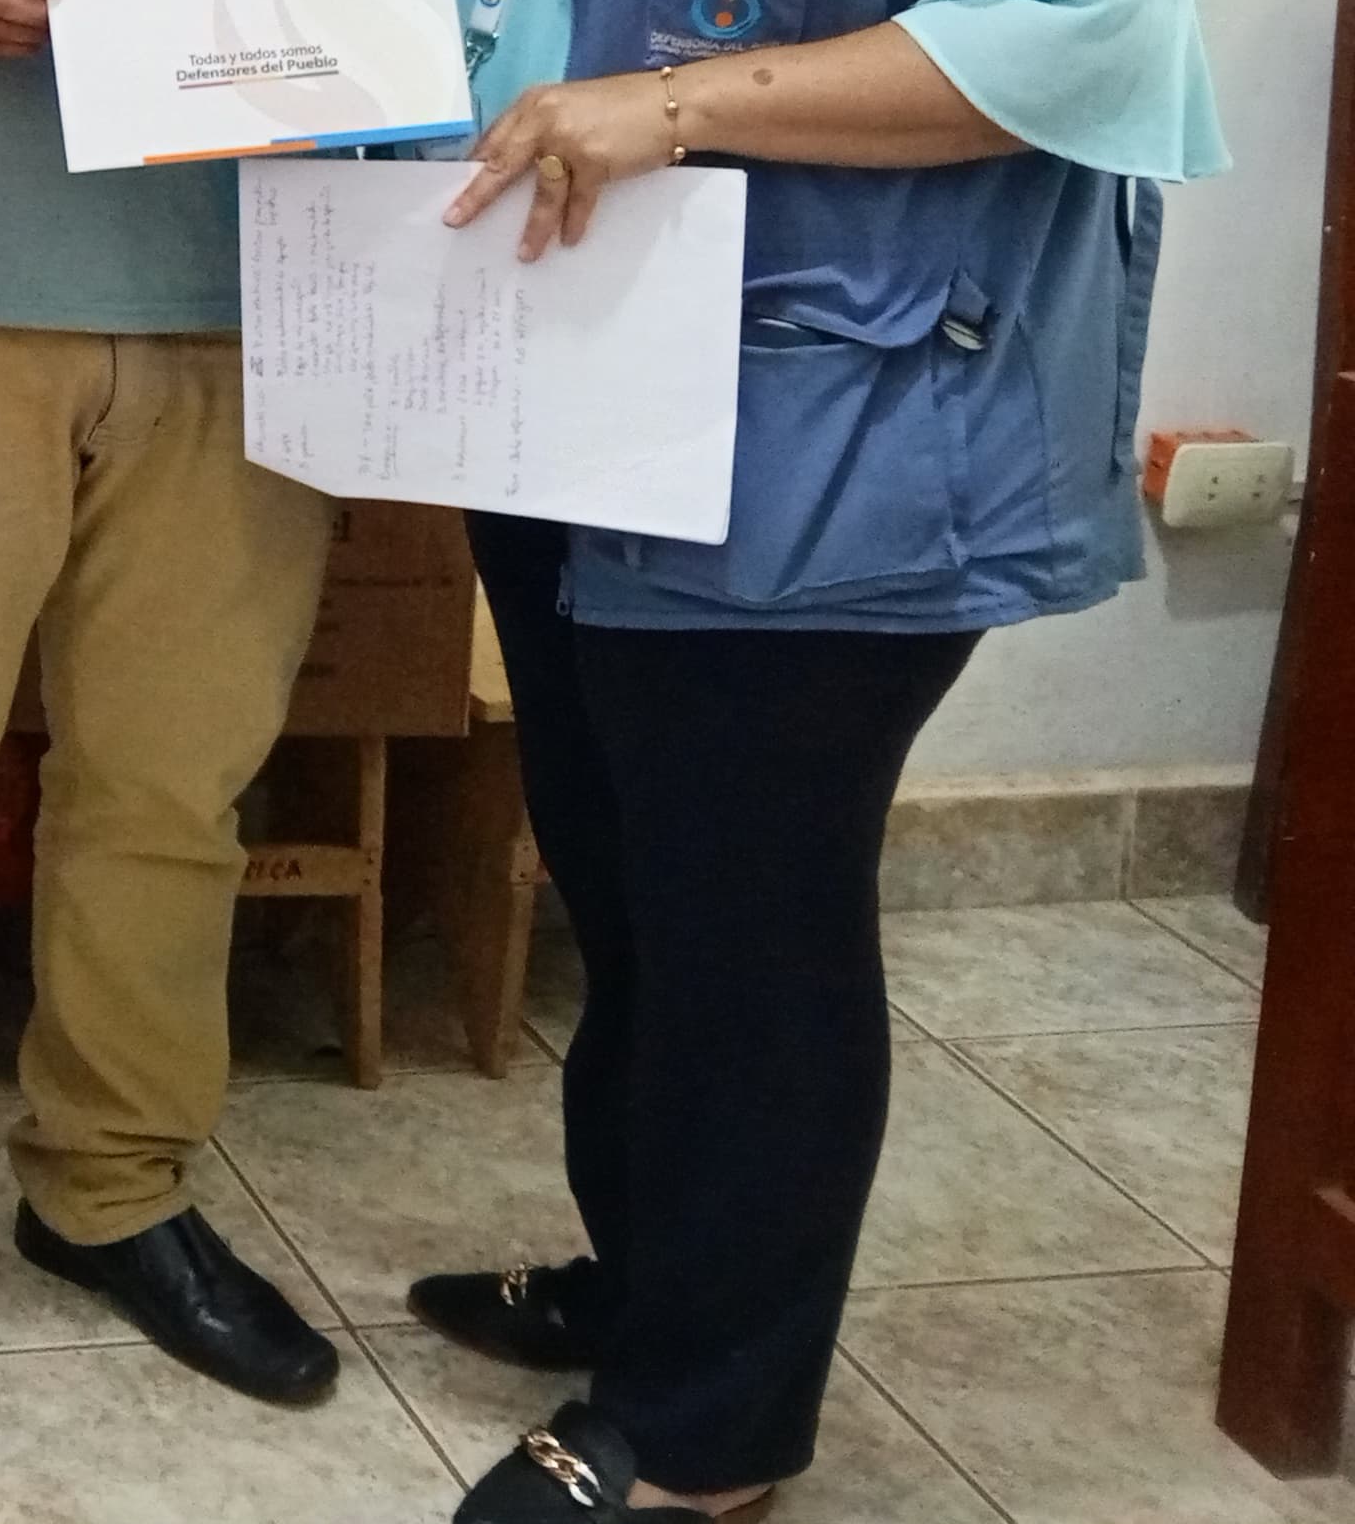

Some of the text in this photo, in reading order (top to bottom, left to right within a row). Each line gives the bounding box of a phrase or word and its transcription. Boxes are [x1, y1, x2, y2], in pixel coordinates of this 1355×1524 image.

[189, 44, 323, 66] Todas y todos somos
[176, 55, 338, 82] Defensores del Pueblo
